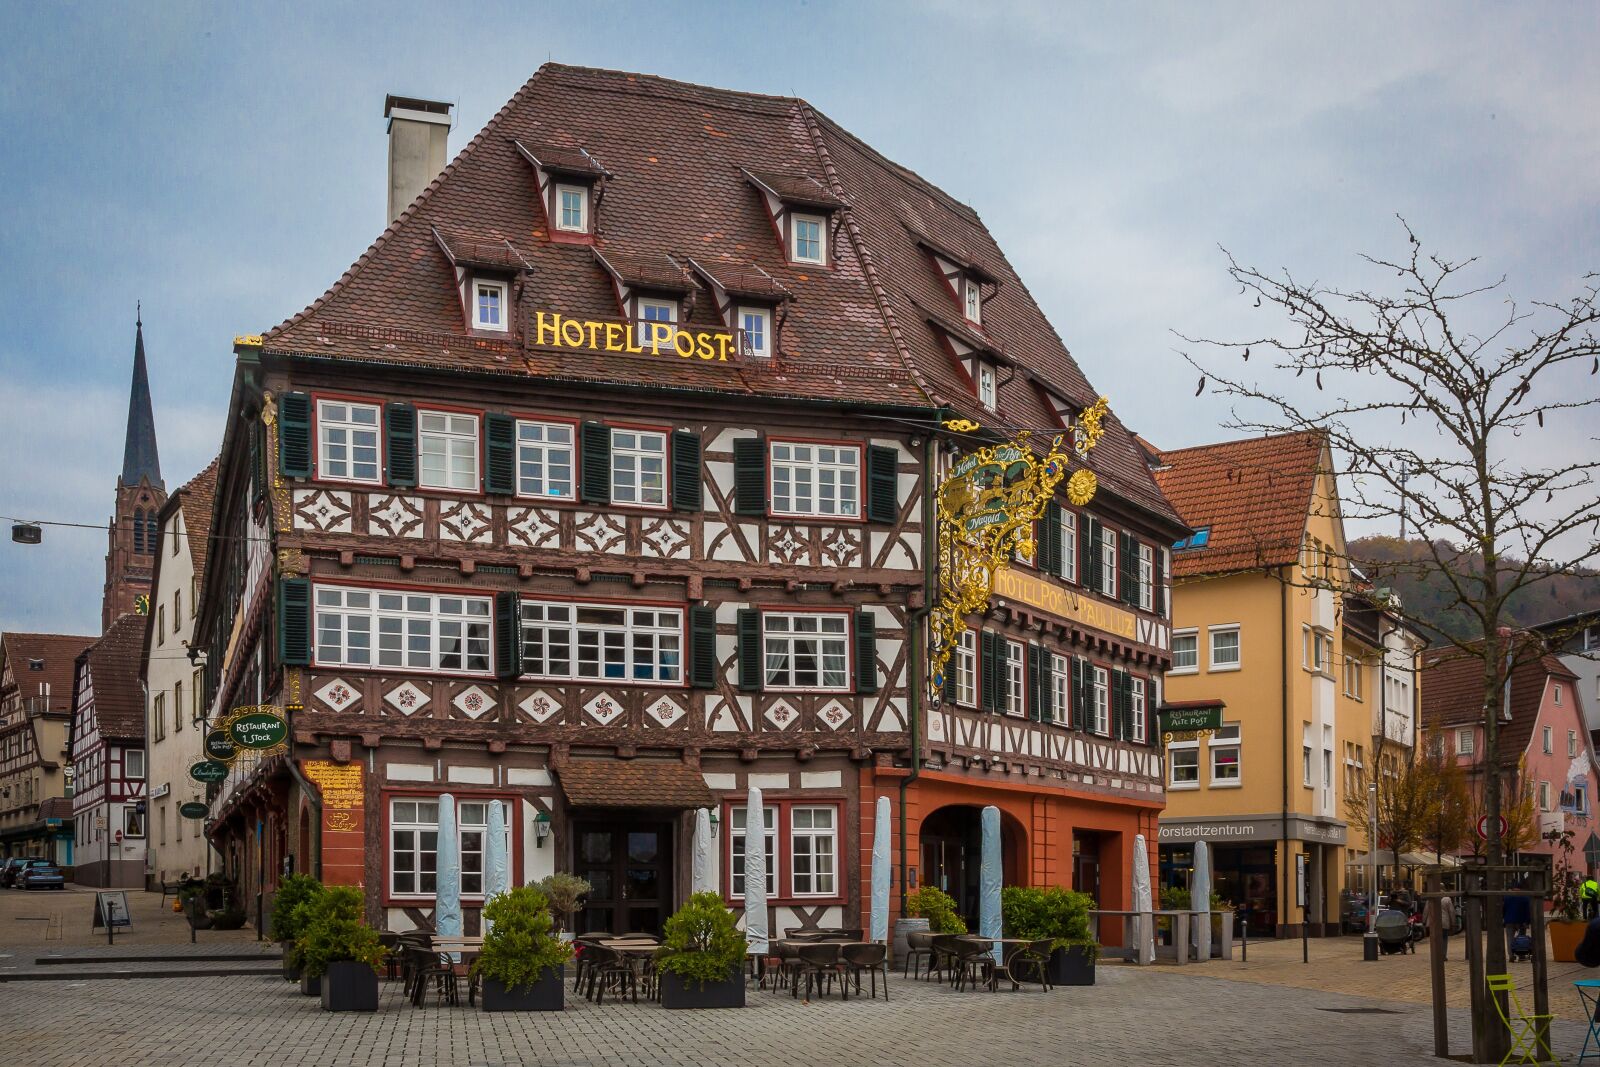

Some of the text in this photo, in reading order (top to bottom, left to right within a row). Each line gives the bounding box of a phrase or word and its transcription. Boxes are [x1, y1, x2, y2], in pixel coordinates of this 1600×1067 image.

[535, 311, 644, 353] HOTEL
[954, 457, 977, 477] Hotel
[967, 511, 1001, 530] Nagold
[998, 568, 1041, 606] HOTEL
